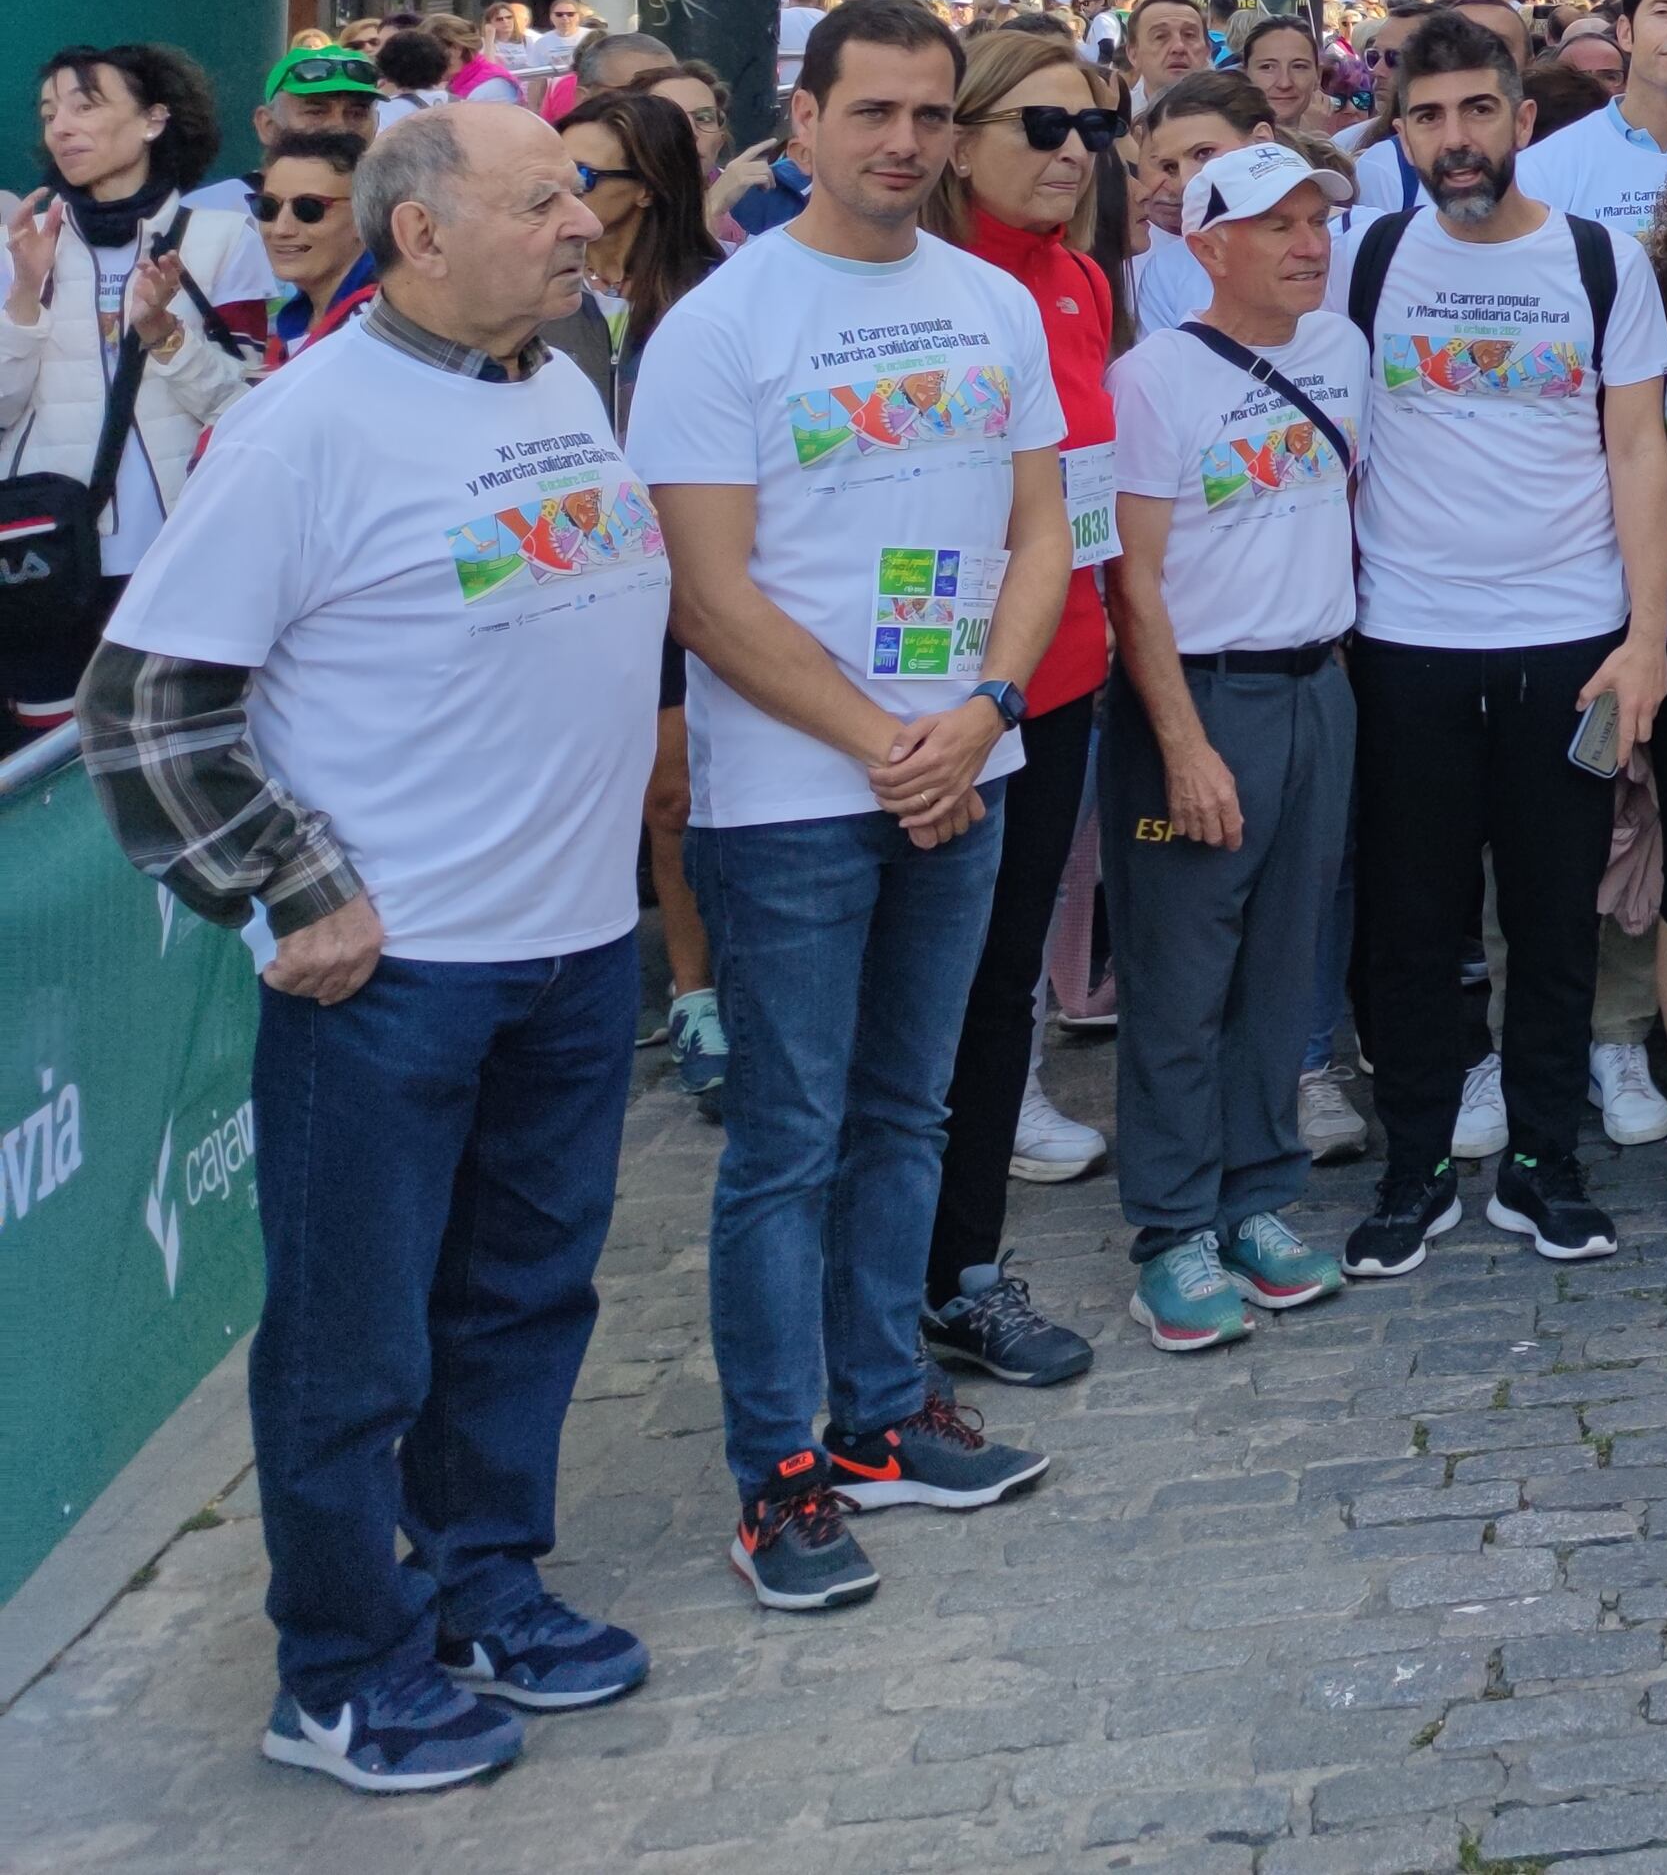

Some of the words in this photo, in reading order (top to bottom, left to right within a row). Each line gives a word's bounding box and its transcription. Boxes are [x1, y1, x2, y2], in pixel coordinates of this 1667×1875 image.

[1621, 191, 1630, 203] XI
[1595, 209, 1600, 219] y
[1603, 204, 1642, 217] Marcha
[1436, 292, 1446, 304] XI
[1450, 292, 1495, 306] Carrera
[1497, 295, 1541, 308] popular
[1407, 305, 1413, 318] y
[1416, 305, 1458, 319] Marcha
[1461, 308, 1511, 322] solidaria
[1513, 310, 1539, 324] Caja
[1541, 310, 1570, 324] Rural
[839, 330, 856, 346] XI
[858, 323, 910, 343] Carrera
[910, 318, 953, 335] popular
[811, 355, 820, 369] y
[822, 343, 877, 368] Marcha
[878, 337, 933, 357] solidaria
[933, 335, 959, 350] Caja
[959, 332, 990, 348] Rural
[1230, 400, 1268, 422] Marcha
[1310, 389, 1329, 402] Caja
[1329, 385, 1349, 399] Rural
[494, 447, 516, 463] XI
[516, 437, 559, 457] Carrera
[466, 482, 479, 496] y
[479, 462, 537, 490] Marcha
[538, 451, 584, 475] solidaria
[585, 448, 606, 464] Caja
[1072, 506, 1109, 550] 1833
